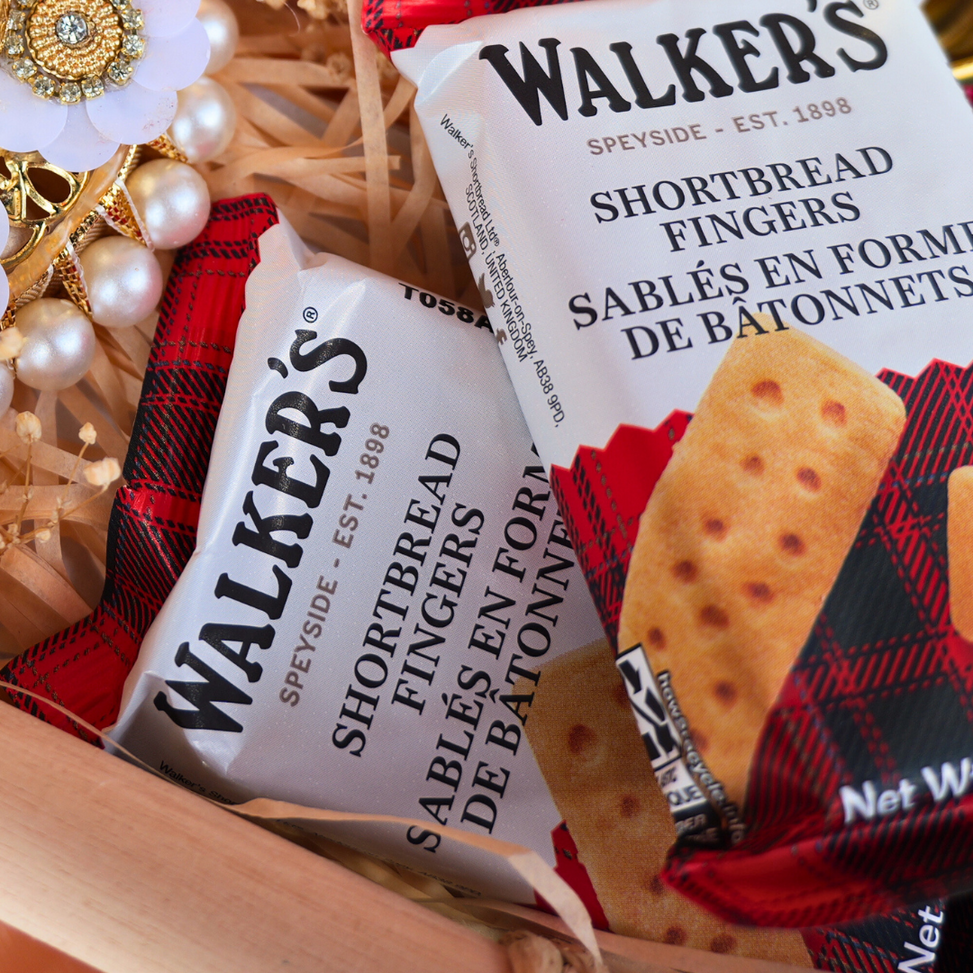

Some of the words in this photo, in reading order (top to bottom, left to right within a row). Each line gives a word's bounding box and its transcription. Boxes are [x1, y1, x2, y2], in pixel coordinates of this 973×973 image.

[587, 123, 707, 155] SPEYSIDE
[733, 110, 788, 134] EST.
[794, 97, 853, 123] 1898
[589, 145, 894, 223] SHORTBREAD
[659, 191, 861, 253] FINGERS
[440, 114, 475, 159] Walker's
[470, 157, 491, 221] Shortbread
[495, 253, 538, 359] Aberlour-on-Spey,
[533, 359, 554, 395] AB38
[568, 260, 750, 329] SABLÉS
[754, 249, 823, 290] EN
[484, 252, 506, 300] UNITED
[500, 300, 528, 363] KINGDOM
[621, 317, 693, 361] DE
[707, 265, 973, 345] BÂTONNETS
[279, 576, 340, 708] SPEYSIDE
[332, 491, 368, 551] EST.
[354, 422, 391, 486] 1898
[331, 432, 462, 758] SHORTBREAD
[391, 502, 485, 715] FINGERS
[485, 507, 575, 756] BÂTONNE
[407, 665, 492, 853] SABLÉS
[468, 585, 517, 659] EN
[461, 760, 511, 834] DE
[839, 780, 916, 824] Net
